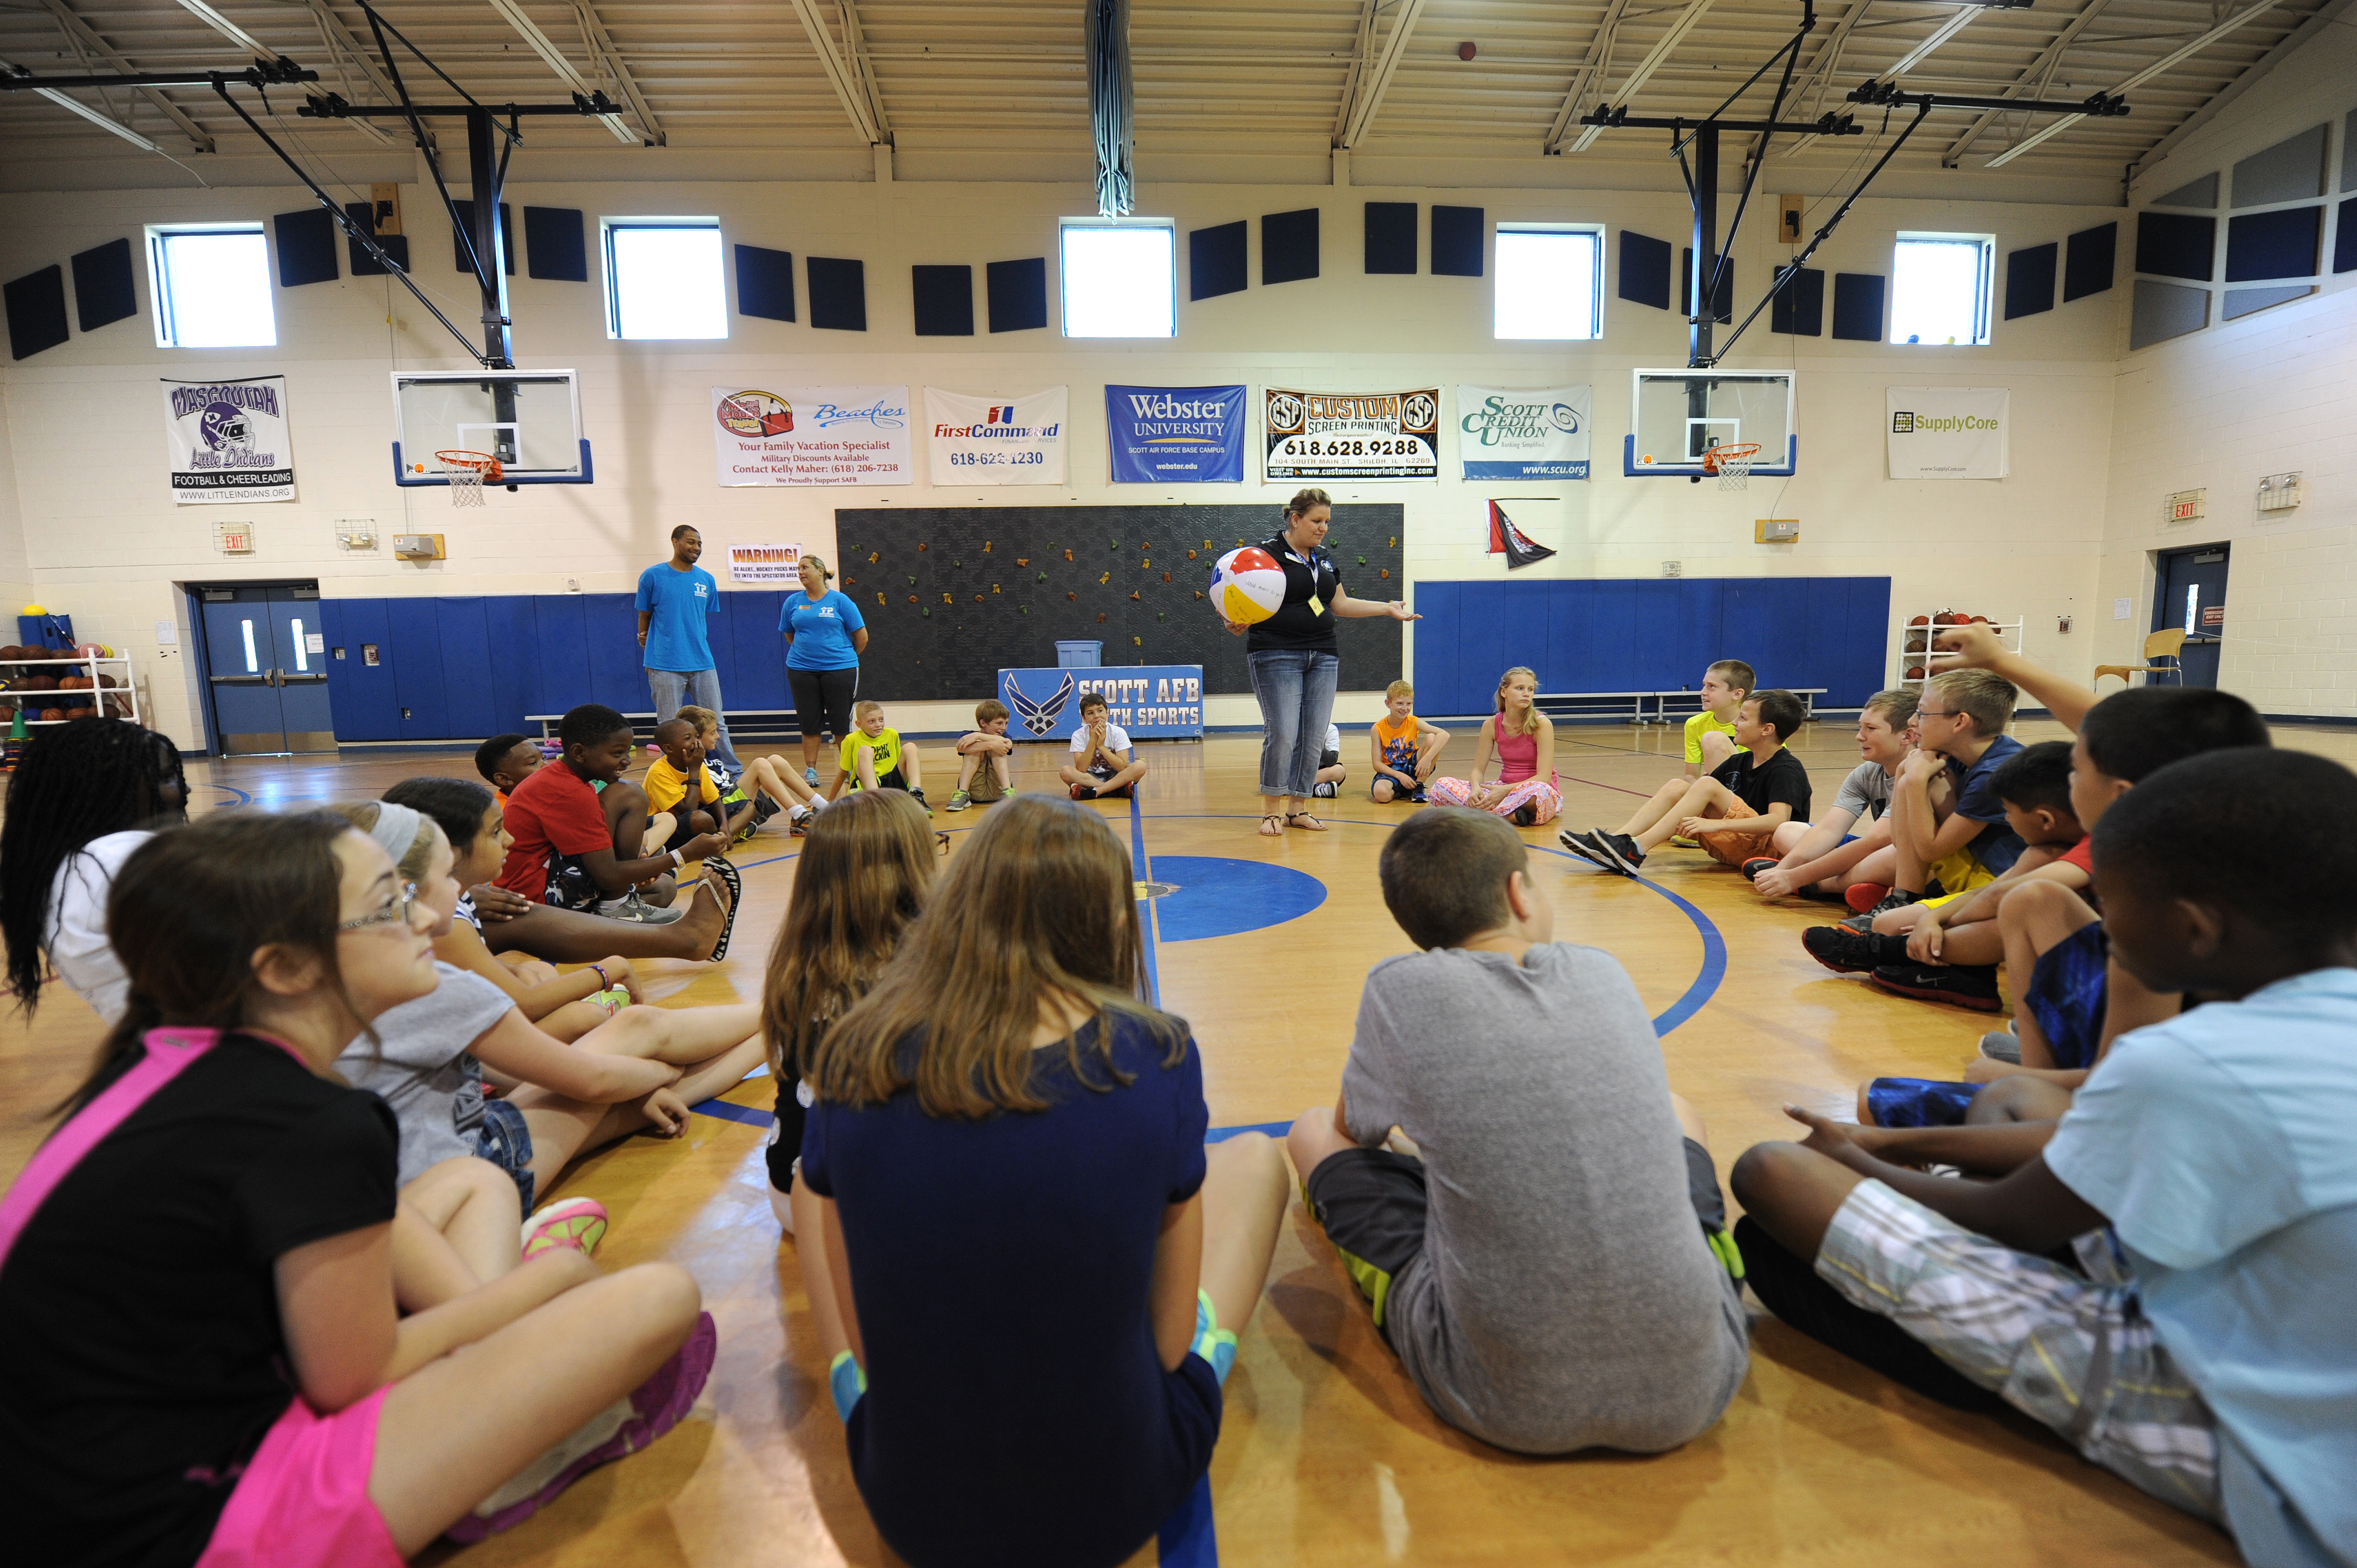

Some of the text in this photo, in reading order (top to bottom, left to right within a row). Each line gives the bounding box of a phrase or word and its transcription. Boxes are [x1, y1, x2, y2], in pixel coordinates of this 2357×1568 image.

[170, 384, 279, 420] MASCOUTAH
[1128, 394, 1225, 419] Webster
[1308, 396, 1398, 419] CUSTOM
[1482, 396, 1548, 416] SCOTT
[722, 408, 760, 419] Mouse
[814, 400, 905, 420] Beaches
[725, 417, 759, 429] Travel
[1134, 422, 1225, 436] UNIVERSITY
[1309, 421, 1397, 435] SCREEN PRINTING
[1461, 414, 1540, 434] CREDIT
[1915, 415, 1998, 432] SupplyCore
[1480, 426, 1548, 446] UNION
[738, 441, 890, 453] Your Family Vacation Specialist
[1285, 440, 1418, 456] 618.628.9288
[189, 447, 275, 470] Little Indians
[761, 455, 790, 464] Military
[951, 452, 1043, 465] 618-622-1230
[733, 464, 898, 474] Contact Kelly Maher: (618) 206-7238
[1301, 467, 1433, 476] www.customscreenprintinginc.com
[1523, 465, 1586, 476] www.scu.org
[174, 473, 291, 486] FOOTBALL & CHEERLEADING
[180, 488, 290, 499] WWW.LITTLEINDIANS.ORG
[2176, 502, 2195, 517] EXIT
[225, 535, 243, 549] EXIT
[732, 548, 797, 563] WARNING!
[1156, 677, 1200, 703] AFB
[1138, 707, 1199, 726] SPORTS
